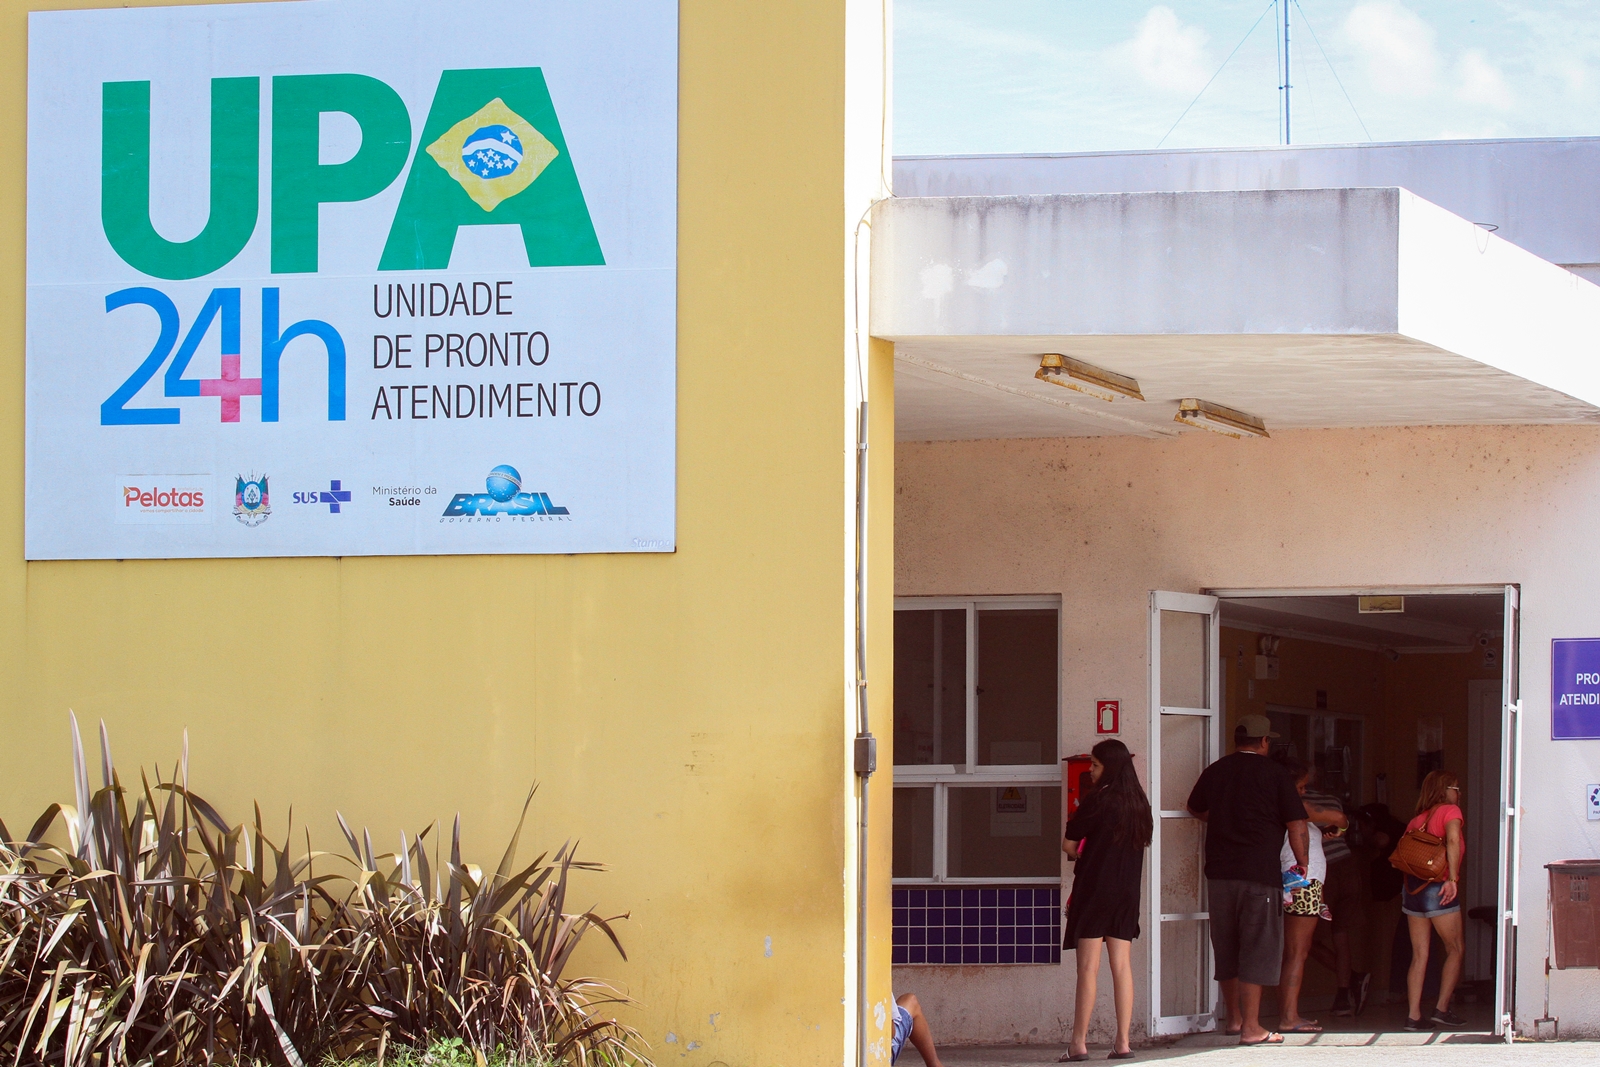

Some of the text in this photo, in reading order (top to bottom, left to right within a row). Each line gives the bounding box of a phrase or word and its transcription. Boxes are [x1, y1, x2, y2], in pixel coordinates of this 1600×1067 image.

[101, 67, 606, 280] UPA
[373, 282, 513, 318] UNIDADE
[100, 286, 347, 426] 24h
[373, 331, 550, 368] DE PRONTO
[371, 382, 602, 420] ATENDIMENTO
[125, 486, 204, 507] Pelotas
[293, 491, 318, 504] SUS
[372, 485, 437, 496] Ministério da
[389, 496, 421, 507] Saúde
[442, 493, 570, 517] BRASIL
[1559, 693, 1600, 706] ATENDI
